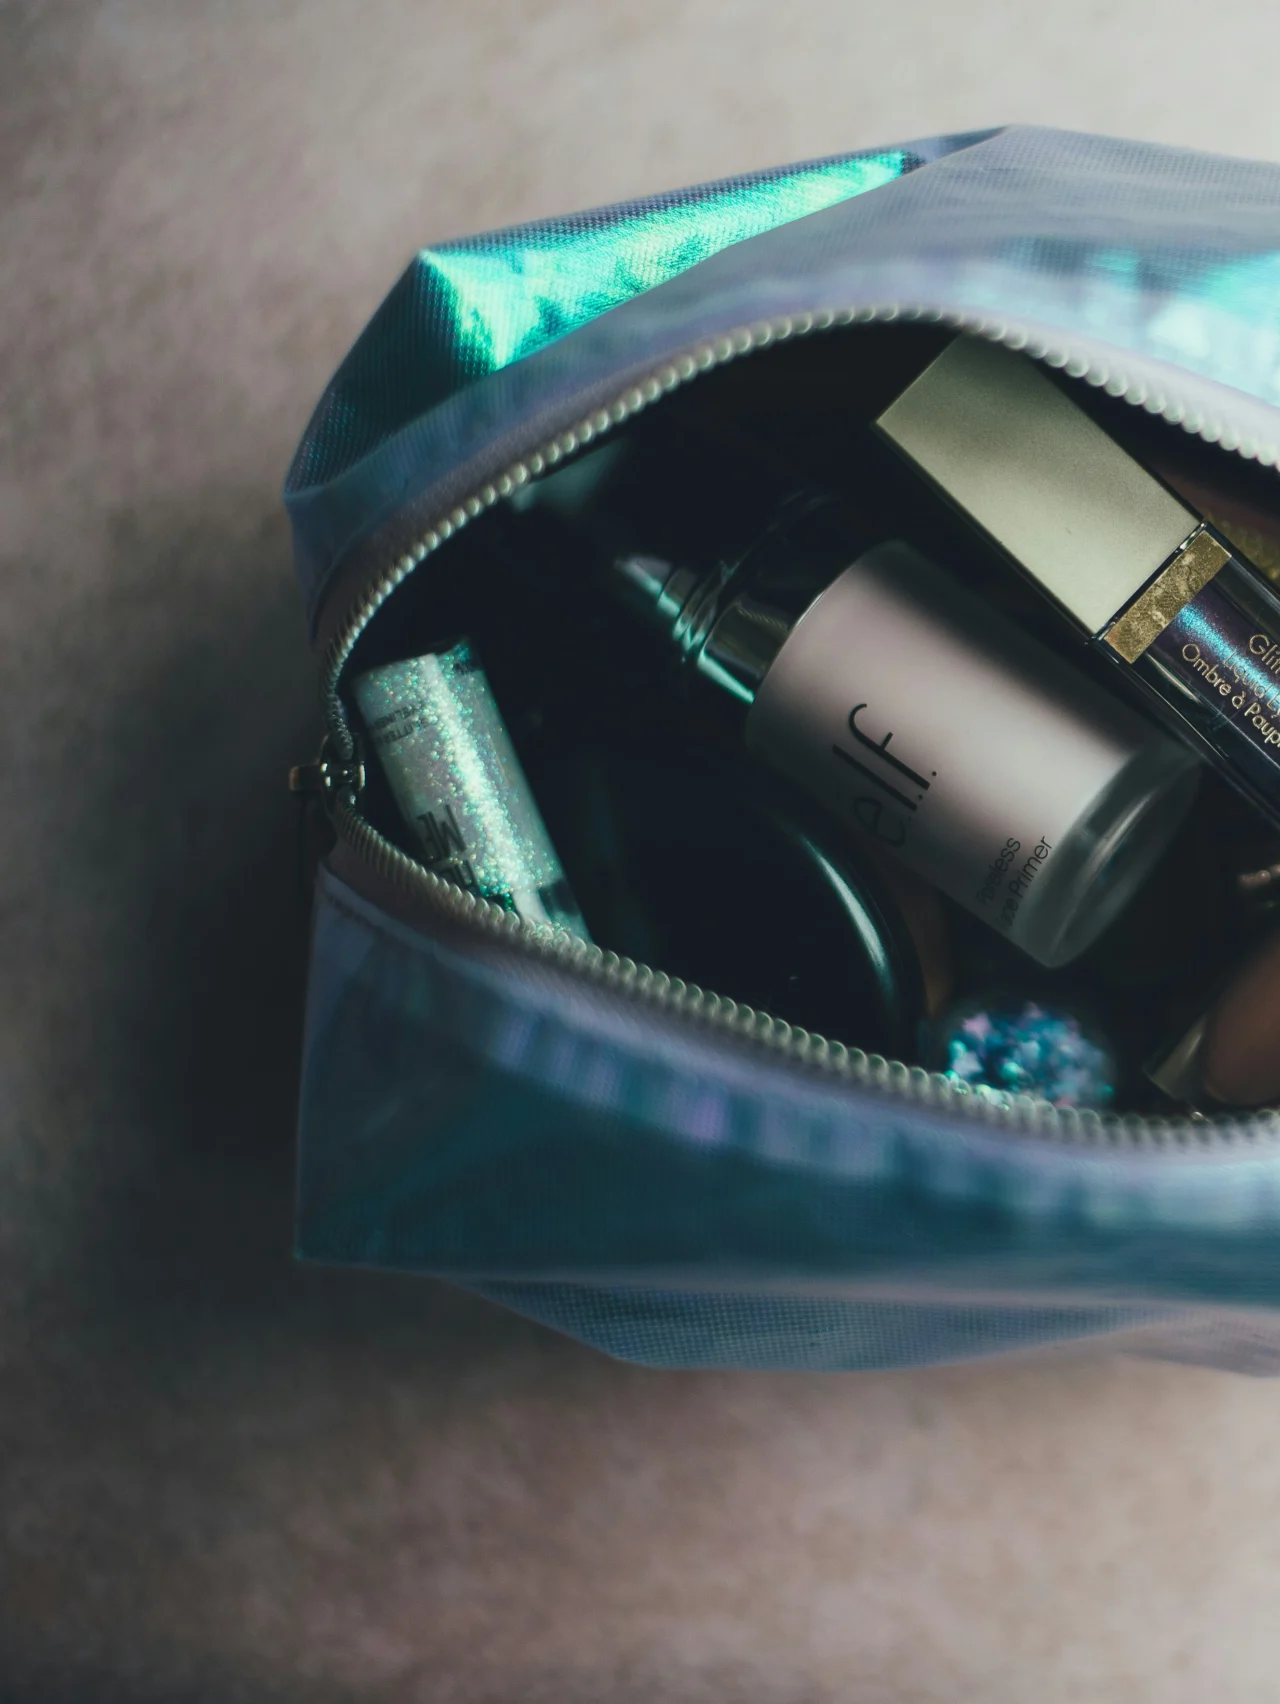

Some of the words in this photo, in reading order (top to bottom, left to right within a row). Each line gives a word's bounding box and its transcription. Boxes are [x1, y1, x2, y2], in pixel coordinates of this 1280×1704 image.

[1182, 643, 1231, 696] Ombre
[1231, 692, 1246, 710] à
[1224, 651, 1266, 698] Liquid
[1008, 835, 1053, 897] Primer
